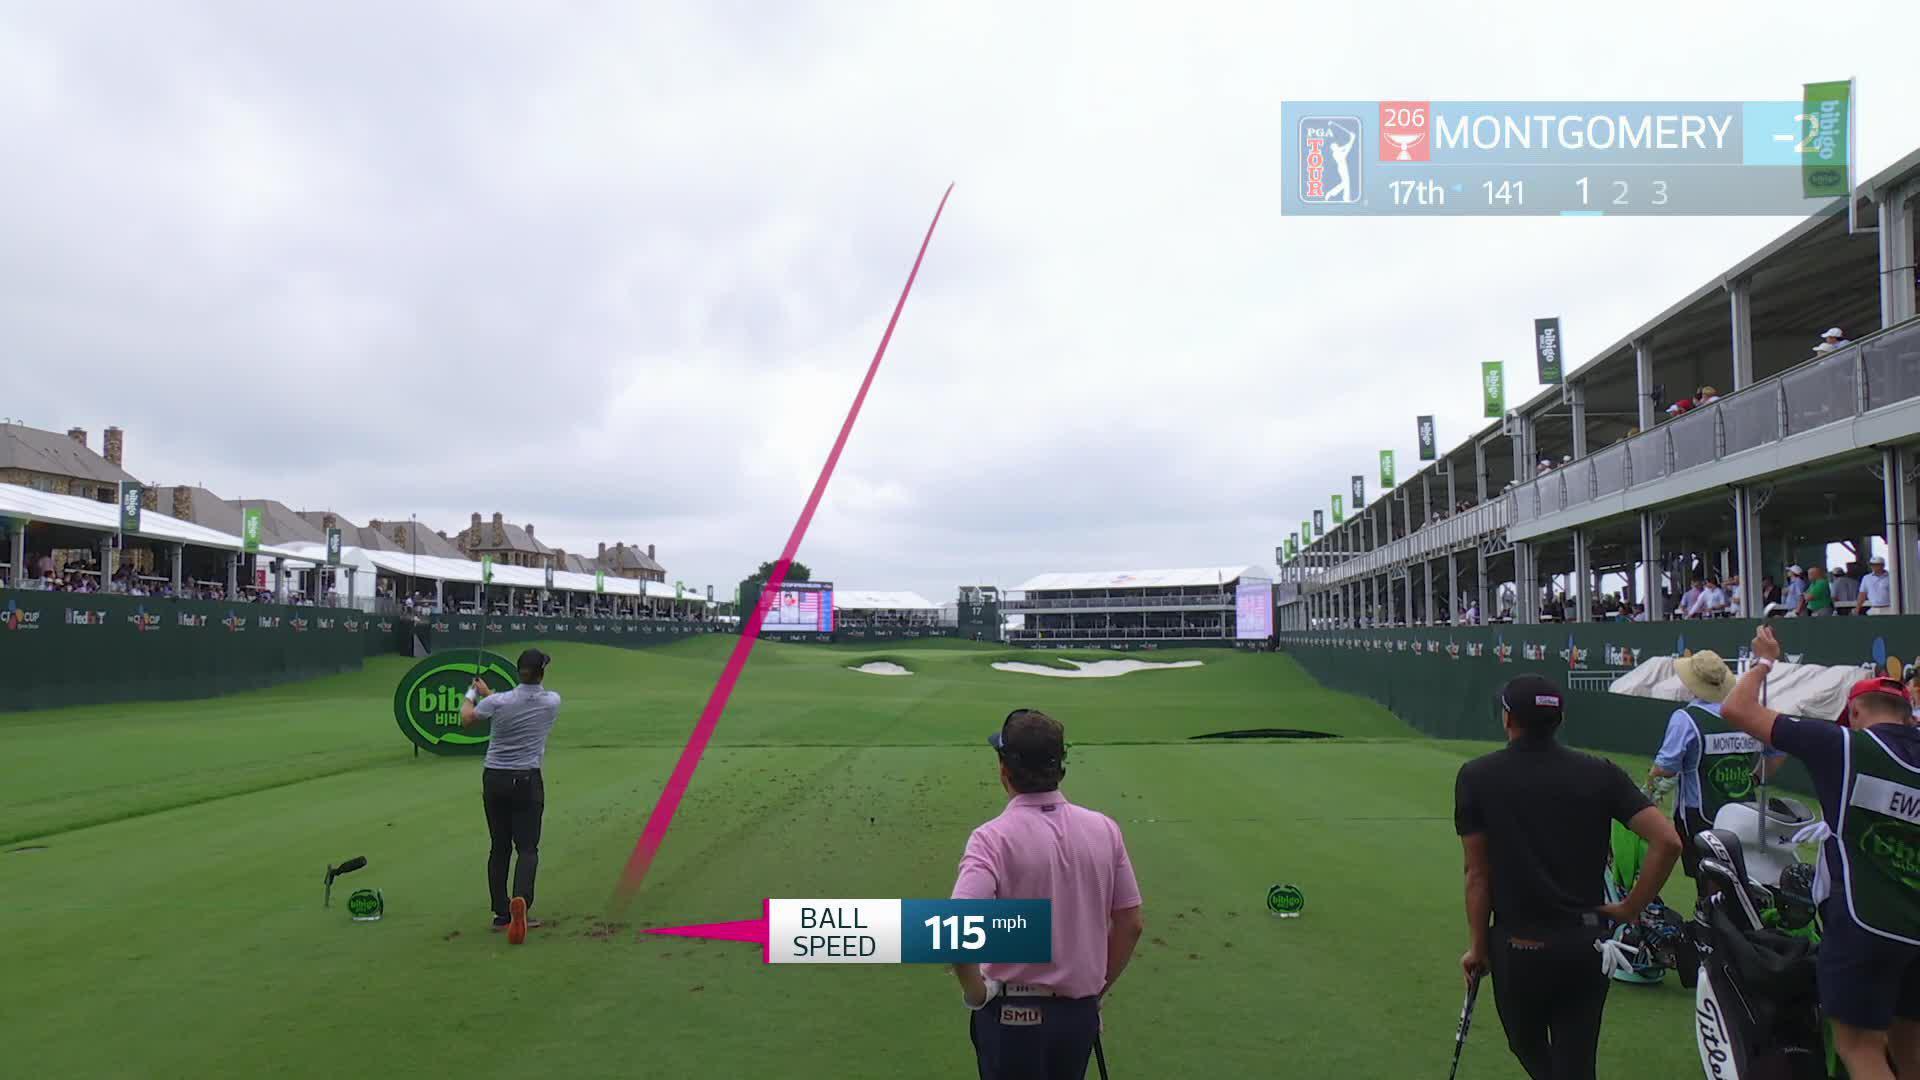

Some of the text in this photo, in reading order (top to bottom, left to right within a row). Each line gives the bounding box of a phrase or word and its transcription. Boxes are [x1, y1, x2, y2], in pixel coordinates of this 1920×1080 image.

[1813, 100, 1839, 160] bibigo
[1542, 328, 1556, 362] bibigo
[972, 607, 982, 616] 17
[1003, 1010, 1039, 1022] SMU
[1696, 998, 1728, 1080] Title
